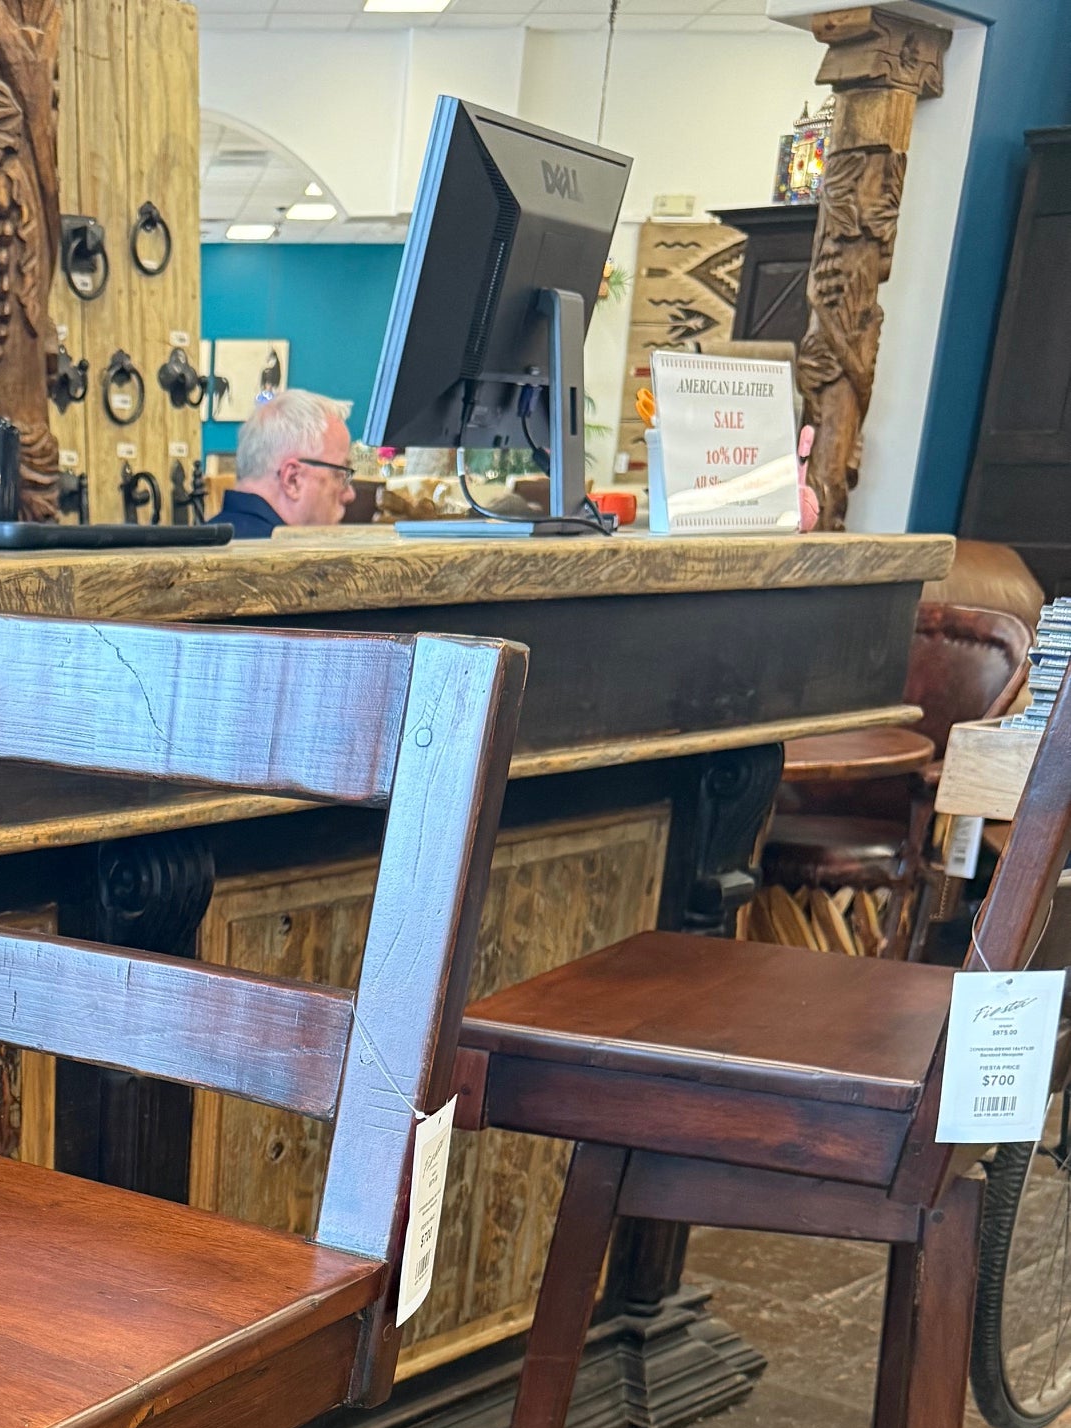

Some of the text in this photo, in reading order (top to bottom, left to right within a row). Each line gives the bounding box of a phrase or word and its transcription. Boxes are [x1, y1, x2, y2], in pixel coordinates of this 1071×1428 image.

[540, 159, 585, 204] DELL
[676, 378, 775, 398] AMERICAN LEATHER
[713, 410, 745, 430] SALE
[705, 447, 759, 466] 10% OFF
[982, 1074, 1016, 1087] $700
